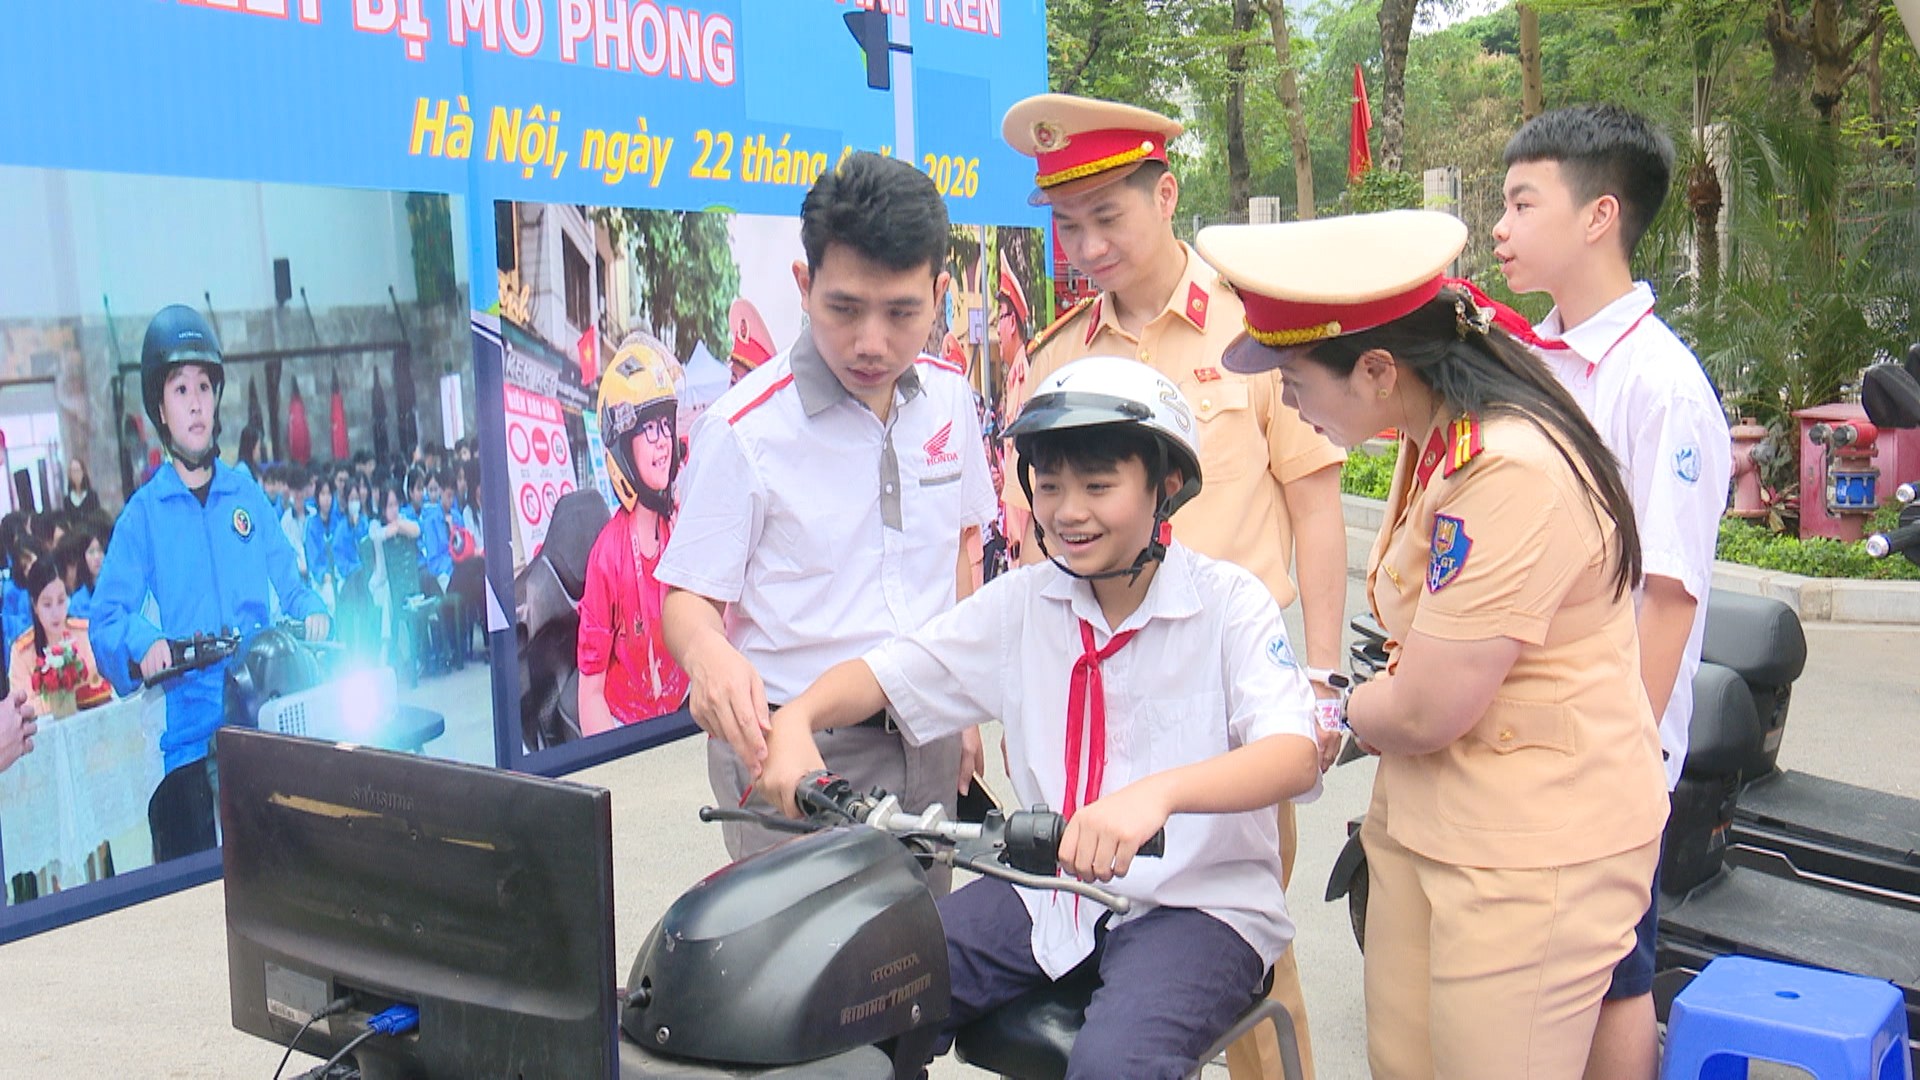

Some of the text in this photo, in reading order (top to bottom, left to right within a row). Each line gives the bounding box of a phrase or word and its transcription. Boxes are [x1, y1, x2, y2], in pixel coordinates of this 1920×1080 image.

[409, 95, 474, 159] Hà
[485, 104, 568, 179] Nội,
[580, 116, 674, 188] ngày
[689, 129, 734, 180] 22
[926, 452, 959, 466] HONDA
[871, 952, 919, 984] HONDA
[841, 995, 887, 1025] RIDING
